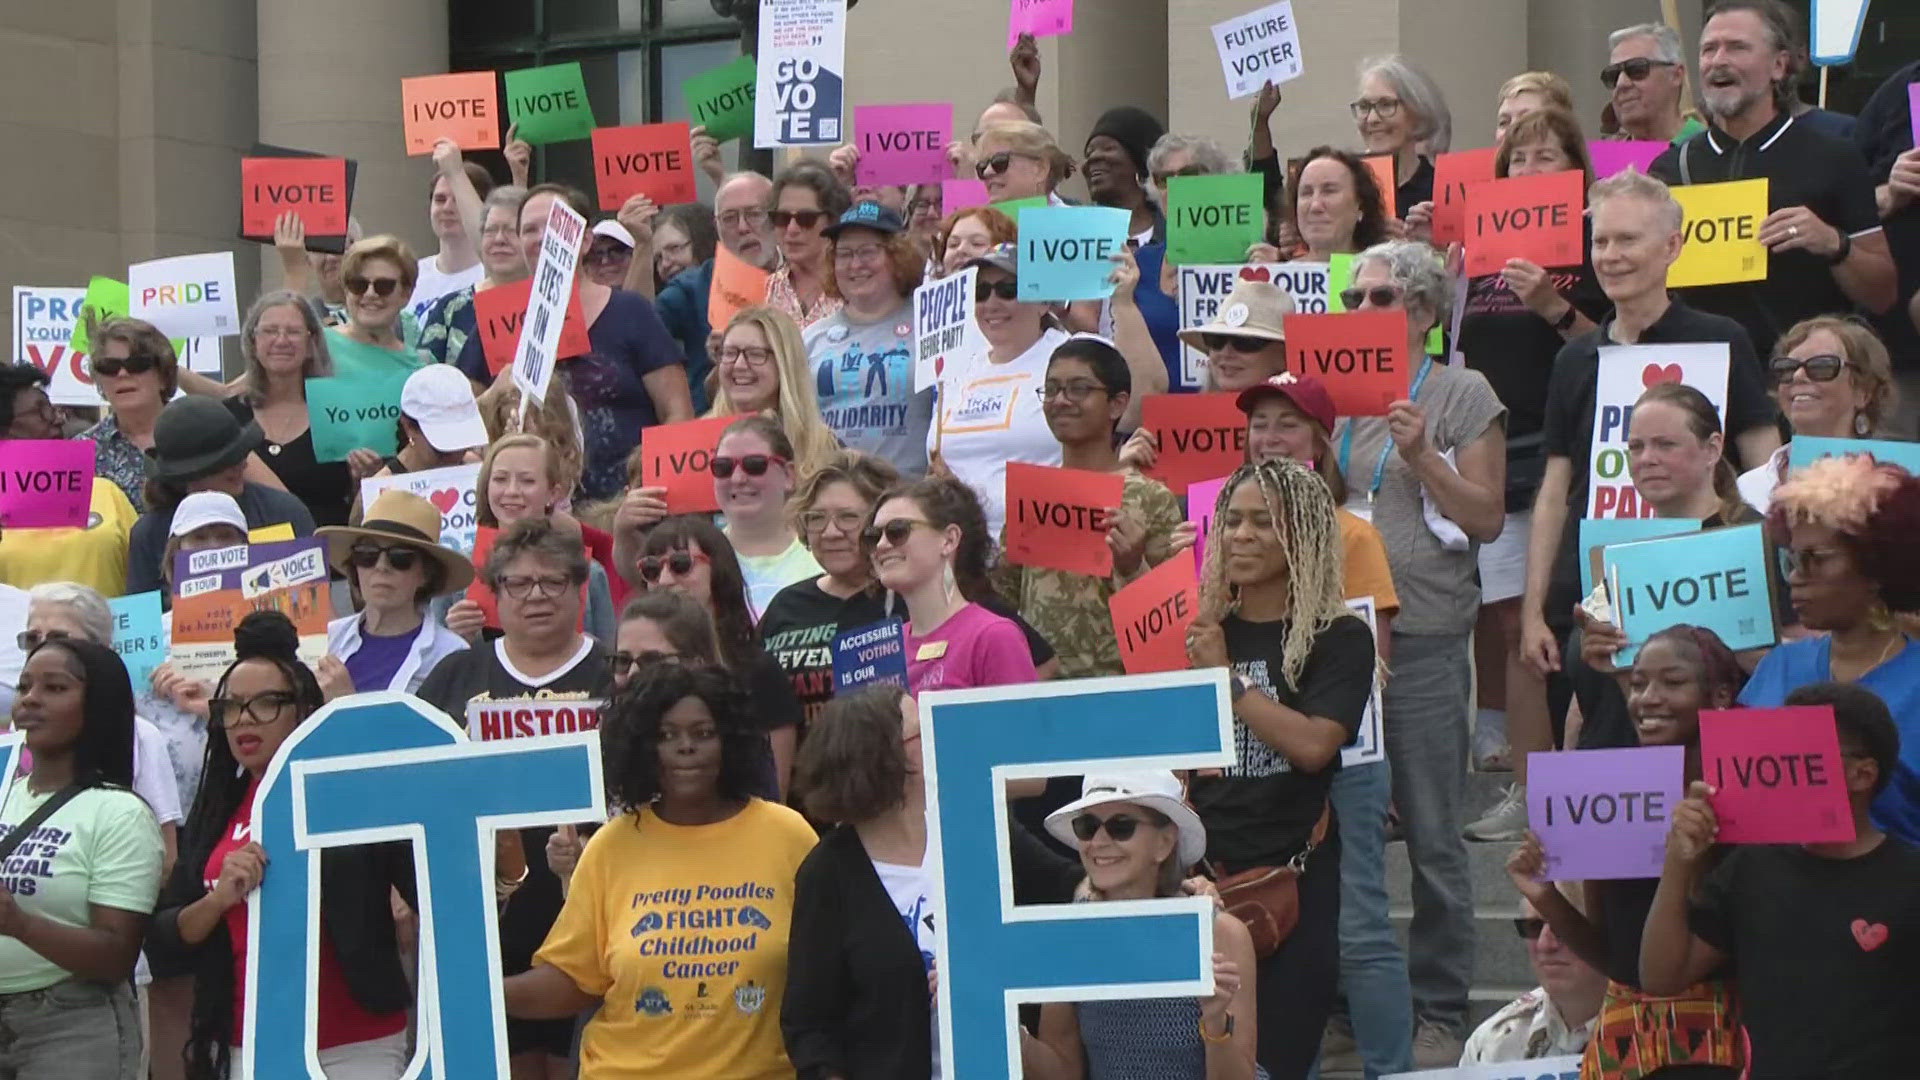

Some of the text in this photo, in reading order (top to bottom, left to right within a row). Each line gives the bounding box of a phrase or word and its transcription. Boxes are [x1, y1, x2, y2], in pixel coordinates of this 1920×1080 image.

[1224, 15, 1288, 50] FUTURE
[773, 57, 820, 83] GO
[1231, 41, 1294, 77] VOTER
[515, 90, 580, 117] I VOTE
[697, 82, 756, 121] I VOTE
[771, 82, 817, 111] VO
[414, 99, 486, 123] I VOTE
[773, 110, 812, 139] TE
[865, 130, 941, 153] I VOTE
[605, 150, 682, 177] I VOTE
[254, 184, 334, 204] I VOTE
[550, 205, 584, 248] HISTORY
[1177, 205, 1250, 228] I VOTE
[1478, 203, 1568, 237] I VOTE
[545, 236, 559, 261] HAS
[1030, 238, 1113, 262] I VOTE
[142, 281, 221, 308] PRIDE
[538, 260, 564, 307] EYES
[1194, 272, 1327, 295] WE OUR
[919, 275, 967, 334] PEOPLE
[1298, 299, 1327, 315] TO
[26, 327, 71, 341] YOUR
[489, 317, 496, 340] I
[533, 303, 550, 346] ON
[941, 323, 965, 351] PARTY
[522, 340, 544, 387] YOU
[1301, 347, 1394, 375] I VOTE
[325, 403, 400, 425] Yo voto
[823, 404, 907, 430] OLIDARITY
[1157, 427, 1246, 453] I VOTE
[655, 456, 661, 477] I
[1, 470, 82, 493] I VOTE
[1018, 499, 1108, 533] I VOTE
[193, 548, 246, 569] YOUR VOTE
[282, 555, 315, 578] VOICE
[184, 580, 192, 594] IS
[1626, 587, 1635, 616] I
[1645, 568, 1750, 612] VOTE
[1125, 589, 1189, 652] I VOTE
[150, 635, 158, 650] 5
[764, 622, 838, 652] VOTING
[839, 623, 899, 652] ACCESSIBLE
[858, 639, 900, 663] VOTING
[854, 665, 875, 683] OUR
[1716, 752, 1828, 789] I VOTE
[1546, 791, 1666, 826] I VOTE
[632, 882, 775, 909] Pretty Poodles
[666, 907, 737, 930] FIGHT
[640, 932, 757, 956] Childhood
[662, 960, 740, 979] Cancer
